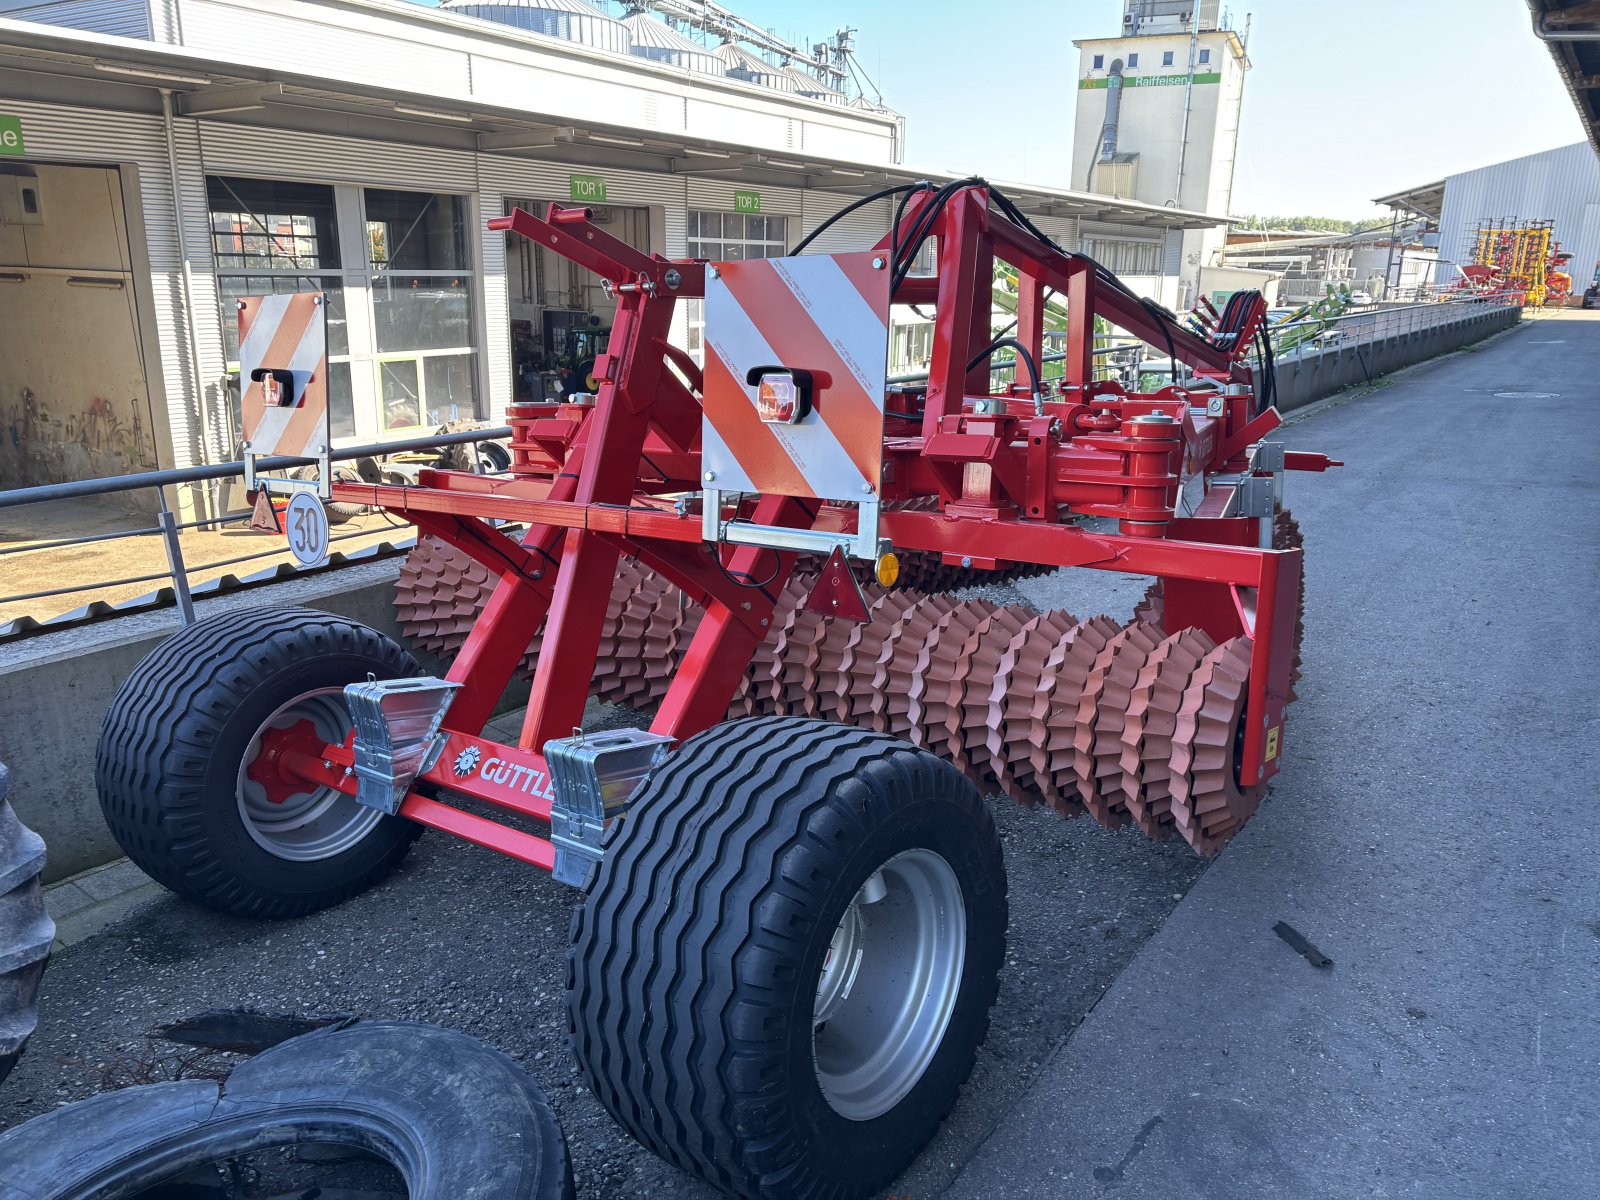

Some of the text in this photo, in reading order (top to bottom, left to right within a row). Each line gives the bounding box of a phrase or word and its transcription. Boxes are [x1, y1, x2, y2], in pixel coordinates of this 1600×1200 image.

[1135, 75, 1188, 87] Raiffeisen
[575, 180, 603, 197] TOR 1
[737, 196, 759, 209] TOR 2
[293, 507, 319, 553] 30
